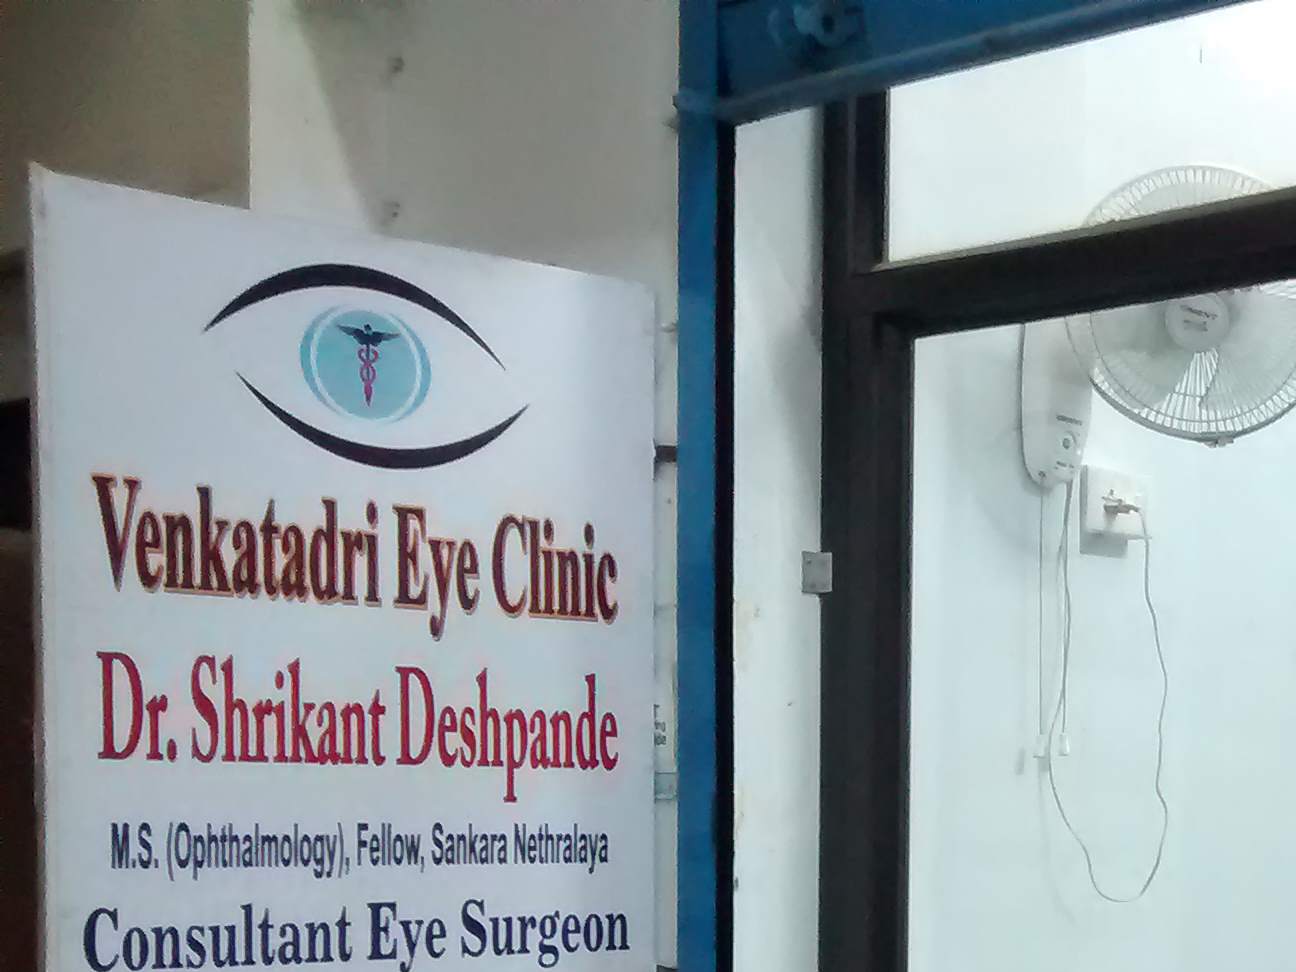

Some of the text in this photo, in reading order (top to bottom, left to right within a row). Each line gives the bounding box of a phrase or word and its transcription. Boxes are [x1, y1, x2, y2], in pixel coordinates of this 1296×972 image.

[91, 473, 619, 641] Venkatadri Eye Clinic
[97, 651, 619, 803] Dr. Shrikant Deshpande
[110, 822, 608, 881] M.S. (Ophthalmology), Fellow, Sankara Nethralaya
[460, 899, 631, 968] Surgeon
